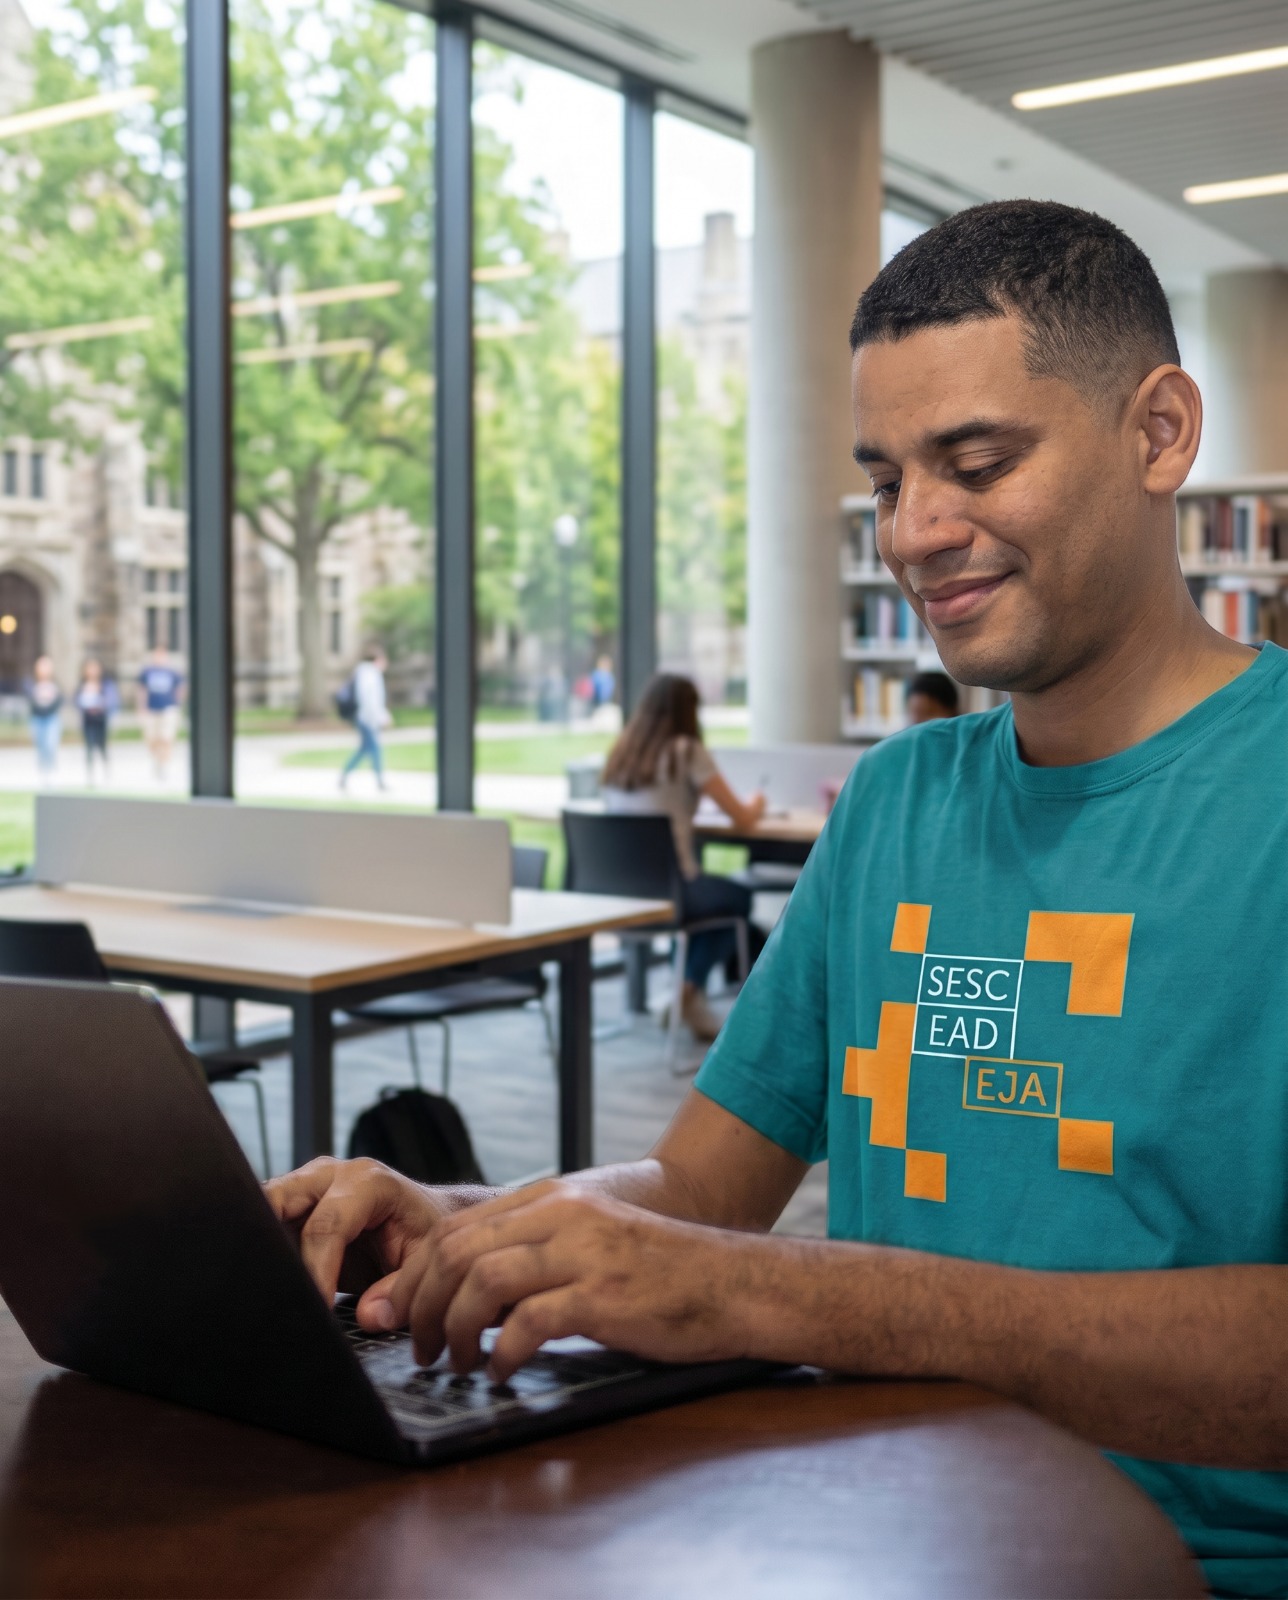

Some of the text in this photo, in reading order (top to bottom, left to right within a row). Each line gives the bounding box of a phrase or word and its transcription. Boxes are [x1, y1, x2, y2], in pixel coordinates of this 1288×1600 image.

[927, 965, 1010, 1001] SESC
[929, 1014, 999, 1050] EAD
[976, 1067, 1047, 1107] EJA
